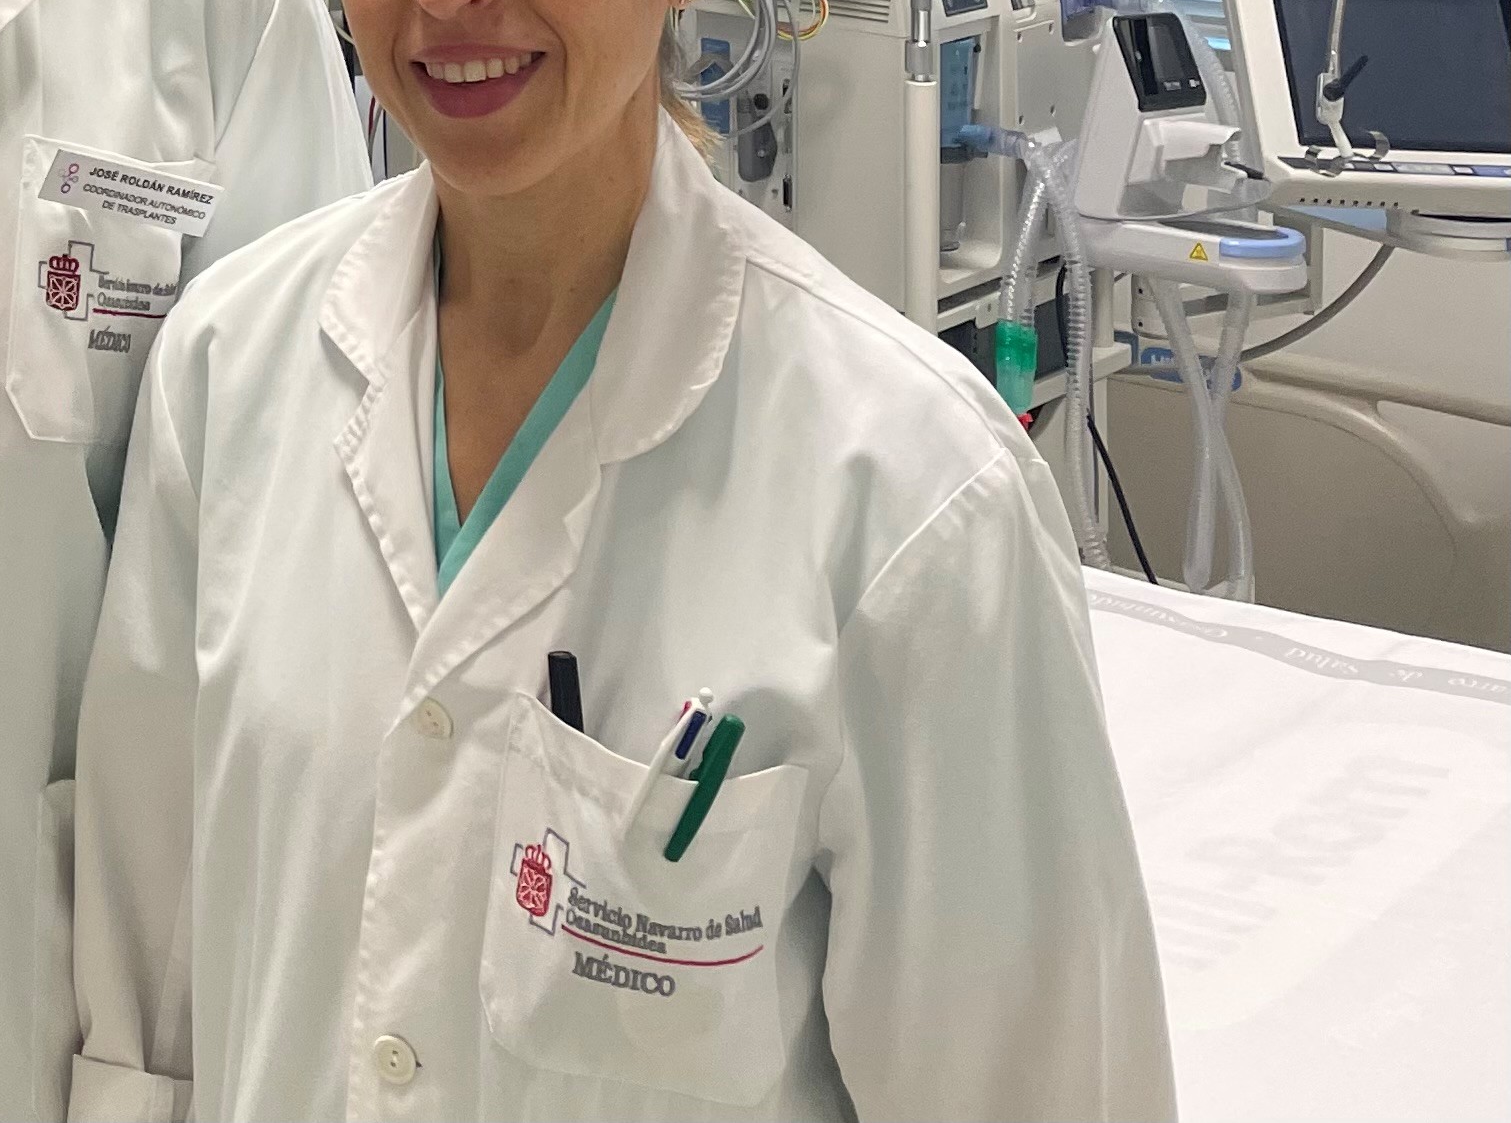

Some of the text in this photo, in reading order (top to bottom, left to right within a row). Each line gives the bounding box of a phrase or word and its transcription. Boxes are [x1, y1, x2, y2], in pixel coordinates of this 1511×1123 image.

[82, 183, 206, 220] COORDINADOR AUTONÓMICO
[89, 167, 214, 205] JOSÉ ROLDÁN RAMÍREZ
[101, 200, 177, 225] DE TRASPLANTES
[568, 887, 763, 942] Servicio Navarro de Salud
[572, 951, 676, 997] MÉDICO
